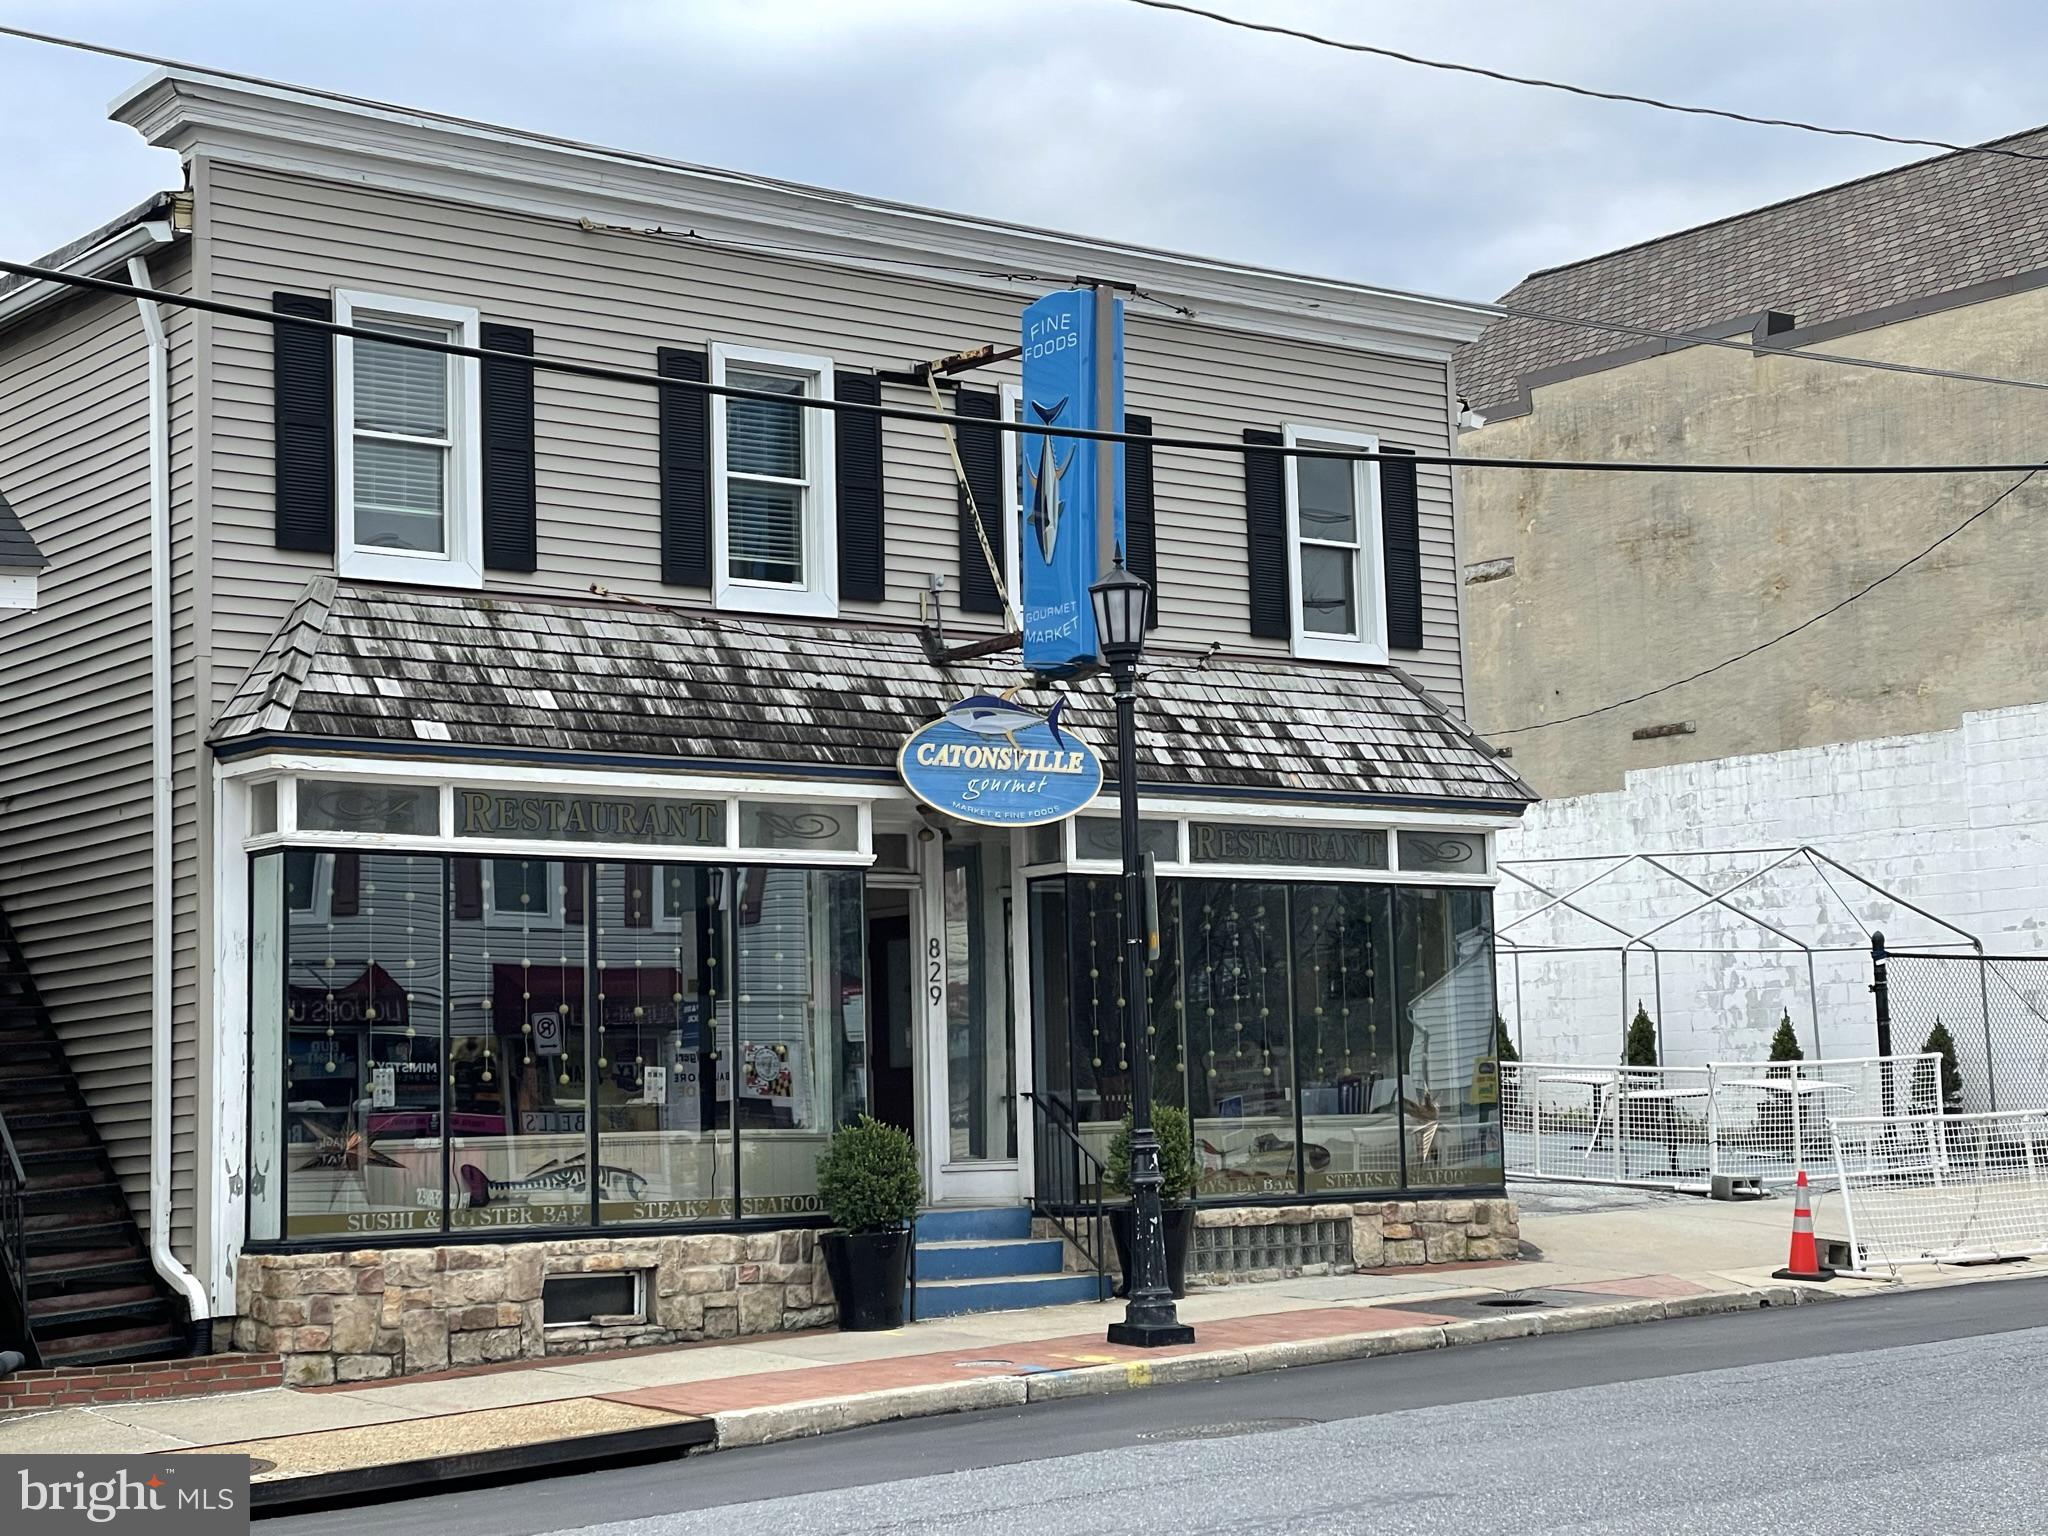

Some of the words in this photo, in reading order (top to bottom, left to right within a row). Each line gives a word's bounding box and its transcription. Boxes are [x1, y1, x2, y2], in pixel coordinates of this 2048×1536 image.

[1030, 313, 1071, 342] FINE
[1025, 332, 1077, 362] FOODS
[1025, 601, 1077, 624] GOURMET
[1024, 615, 1079, 644] MARKET
[916, 742, 1084, 774] CATONSVILLE
[962, 775, 1048, 800] gourmet
[461, 791, 718, 842] RESTAURANT
[952, 801, 992, 816] MARKET
[1004, 811, 1026, 819] FINE
[1028, 805, 1060, 817] FOODS
[1195, 824, 1381, 866] RESTAURANT
[929, 938, 942, 1006] 829
[1326, 1171, 1383, 1189] STEAKS
[1388, 1170, 1398, 1185] &
[347, 1211, 415, 1232] SUSHI
[424, 1211, 441, 1228] &
[633, 1200, 711, 1219] STEAKS
[718, 1200, 732, 1215] &
[742, 1195, 825, 1214] SEAFOO
